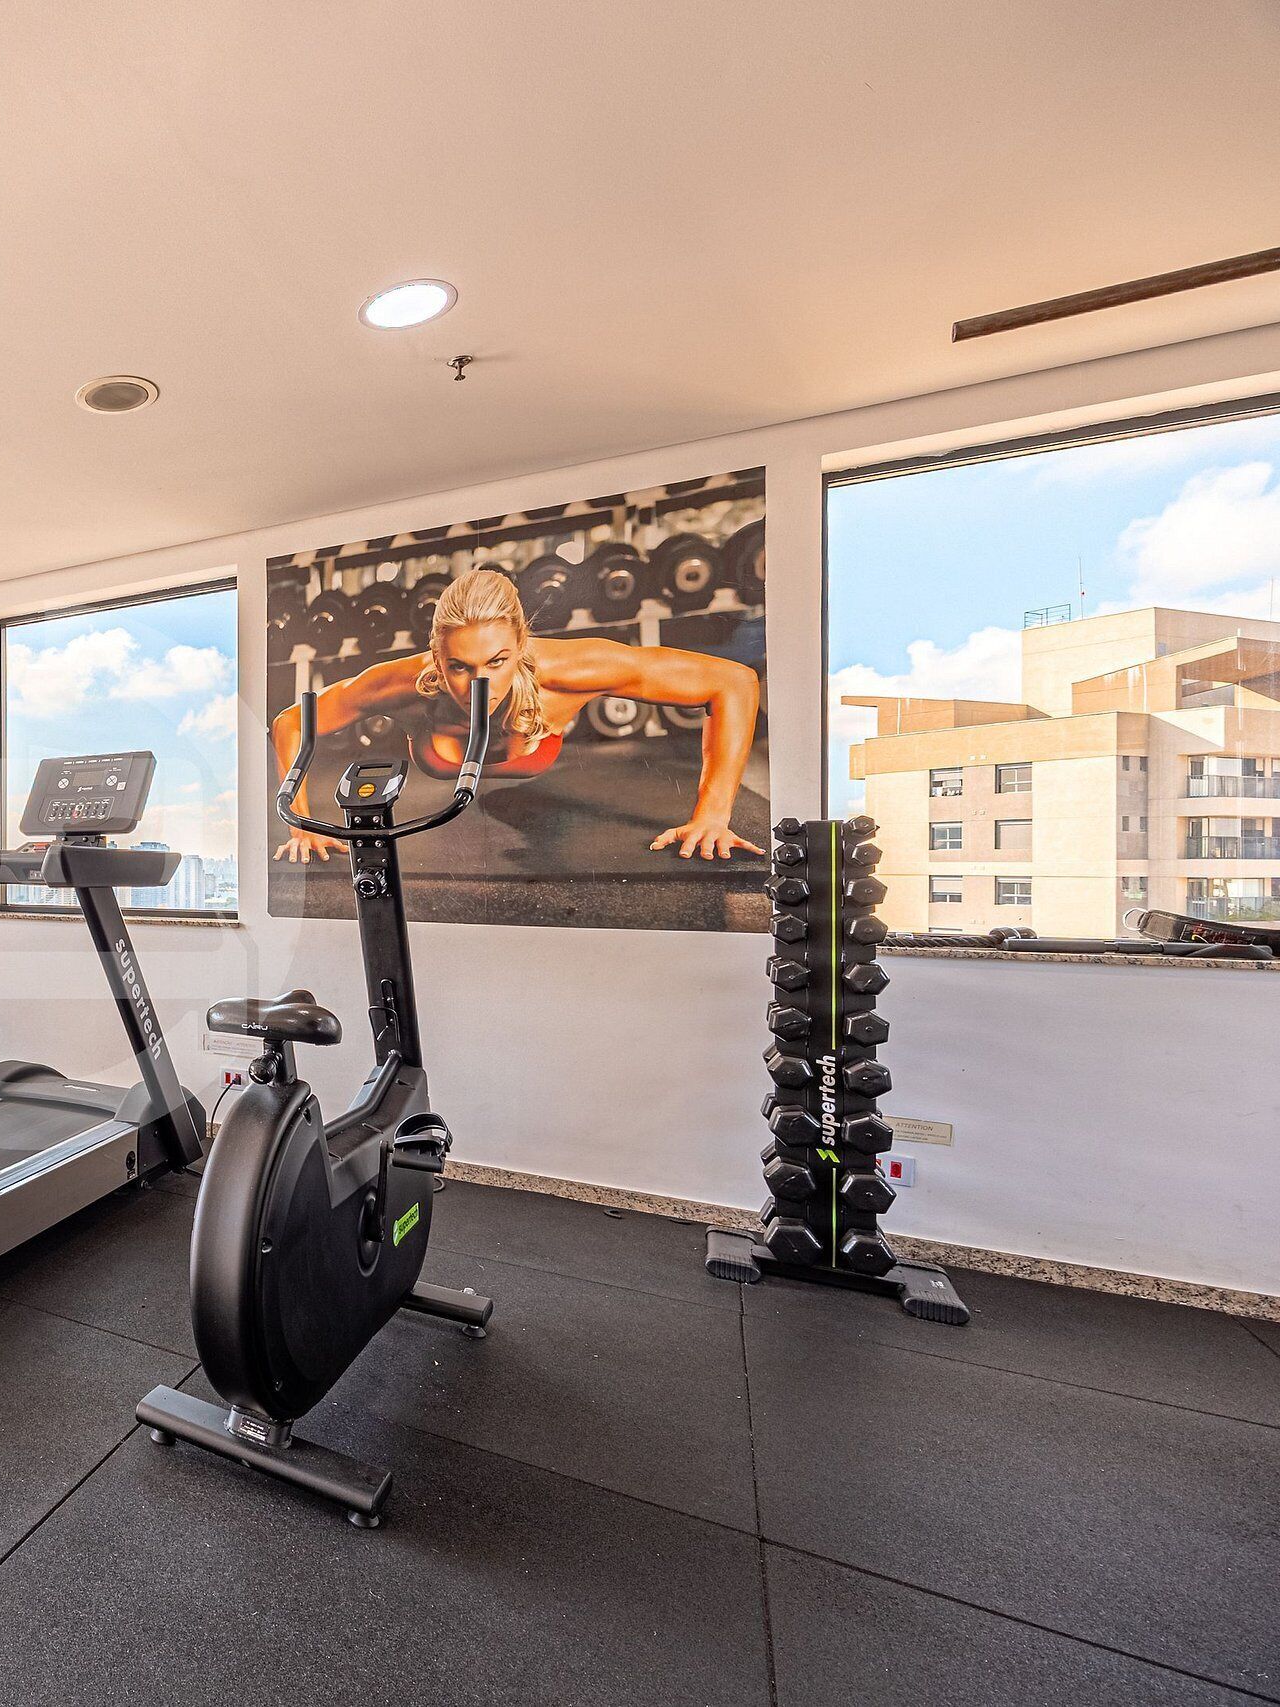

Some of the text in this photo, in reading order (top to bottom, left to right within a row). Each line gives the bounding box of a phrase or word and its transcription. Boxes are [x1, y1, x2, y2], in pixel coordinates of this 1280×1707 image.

[115, 939, 162, 1060] supertech
[816, 1055, 841, 1146] supertech
[895, 1122, 934, 1131] ATTENTION
